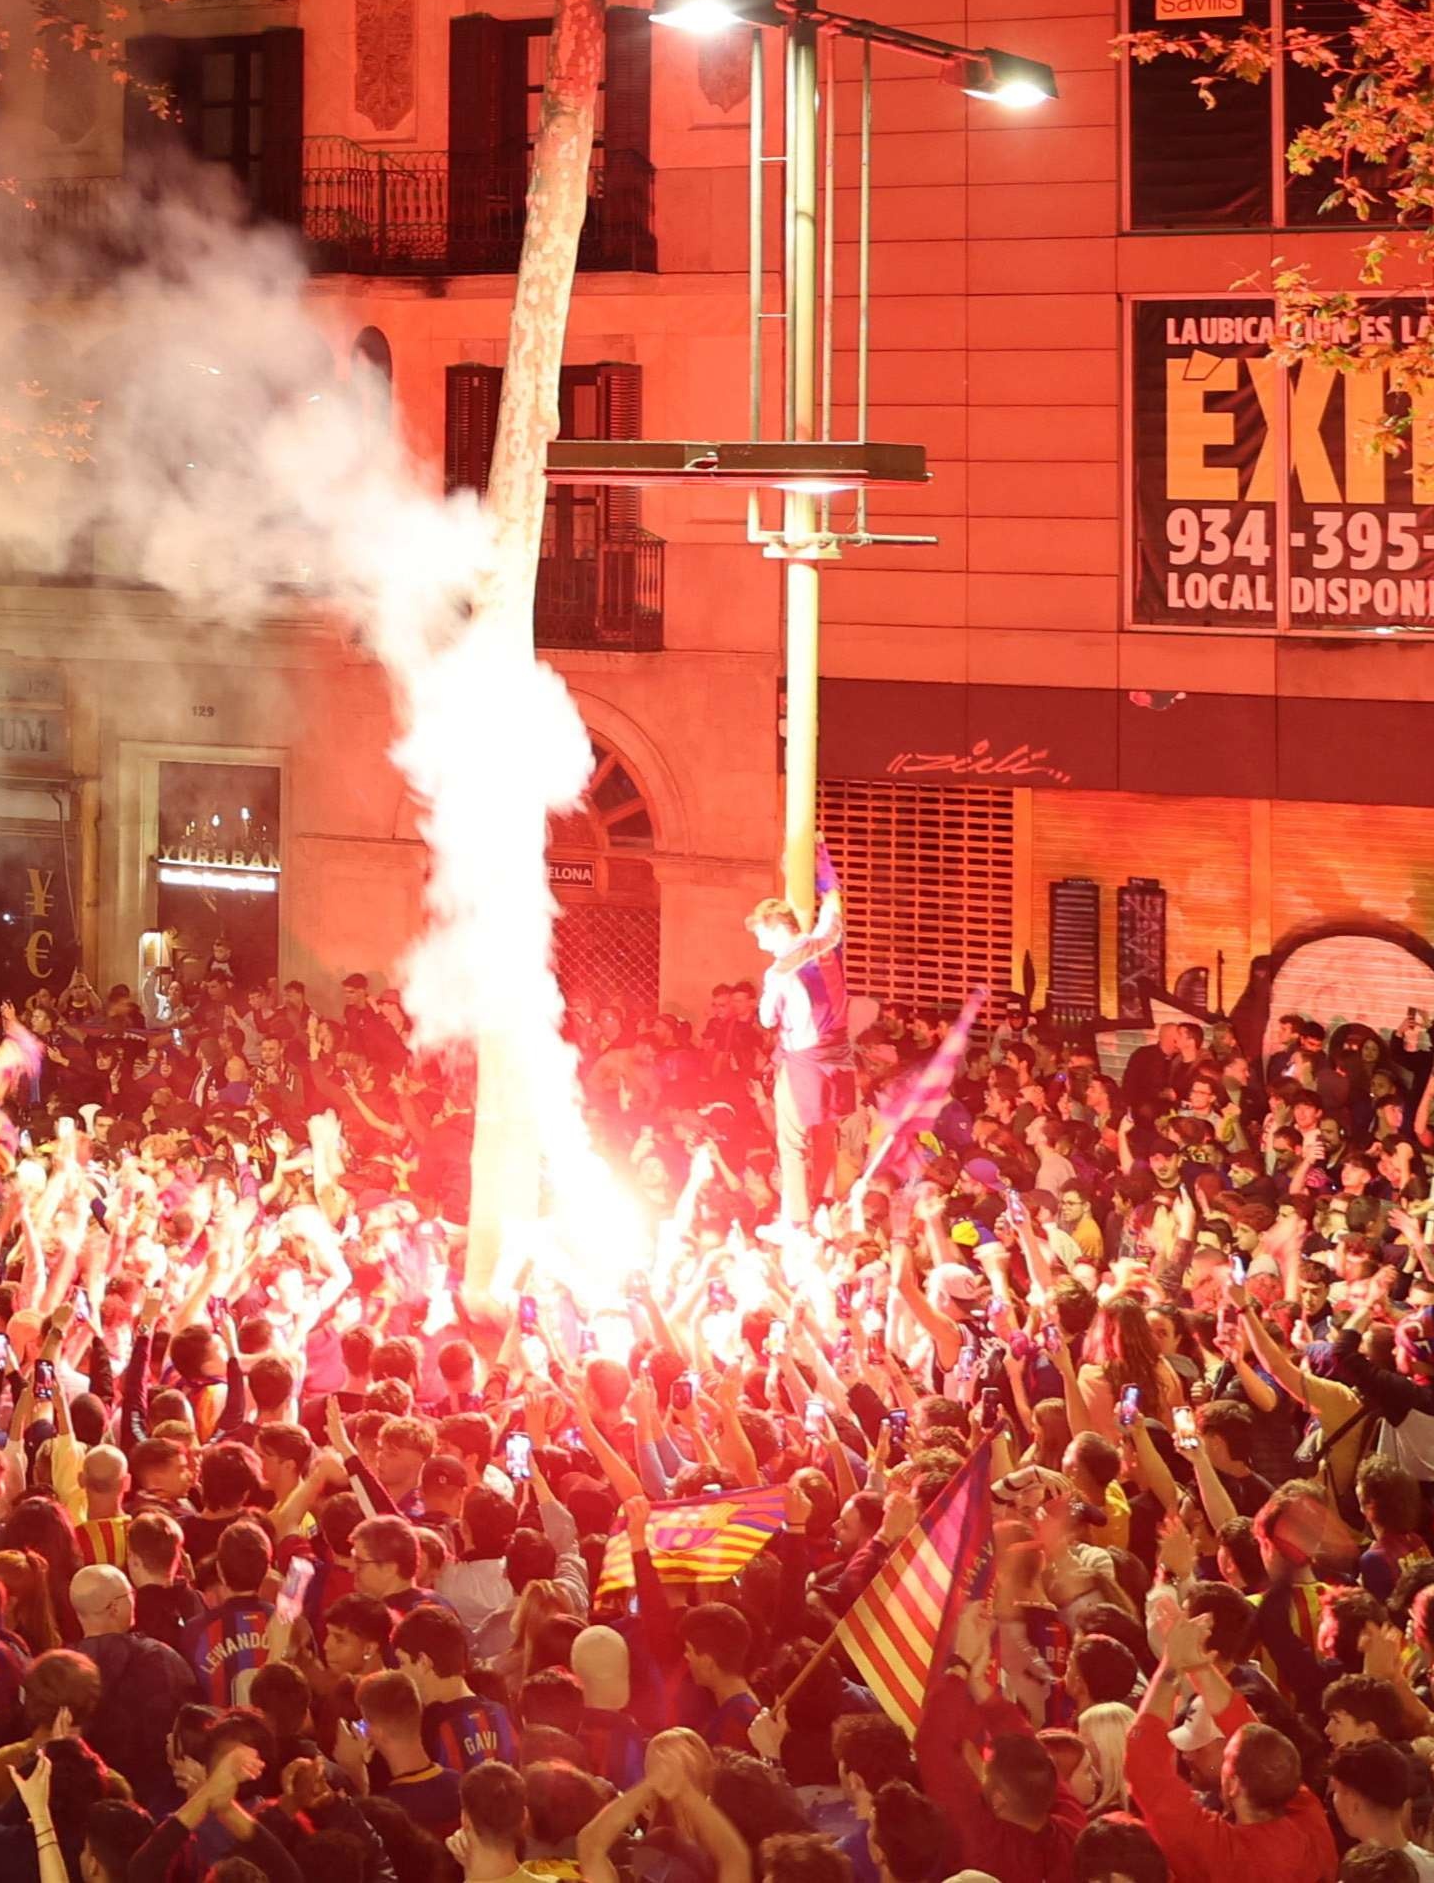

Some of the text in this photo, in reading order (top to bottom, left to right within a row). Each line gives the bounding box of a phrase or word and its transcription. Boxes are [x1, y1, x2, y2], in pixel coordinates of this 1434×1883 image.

[1359, 315, 1392, 344] ES
[1167, 573, 1274, 612] LOCAL
[192, 706, 215, 717] 129
[464, 1731, 497, 1756] GAVI
